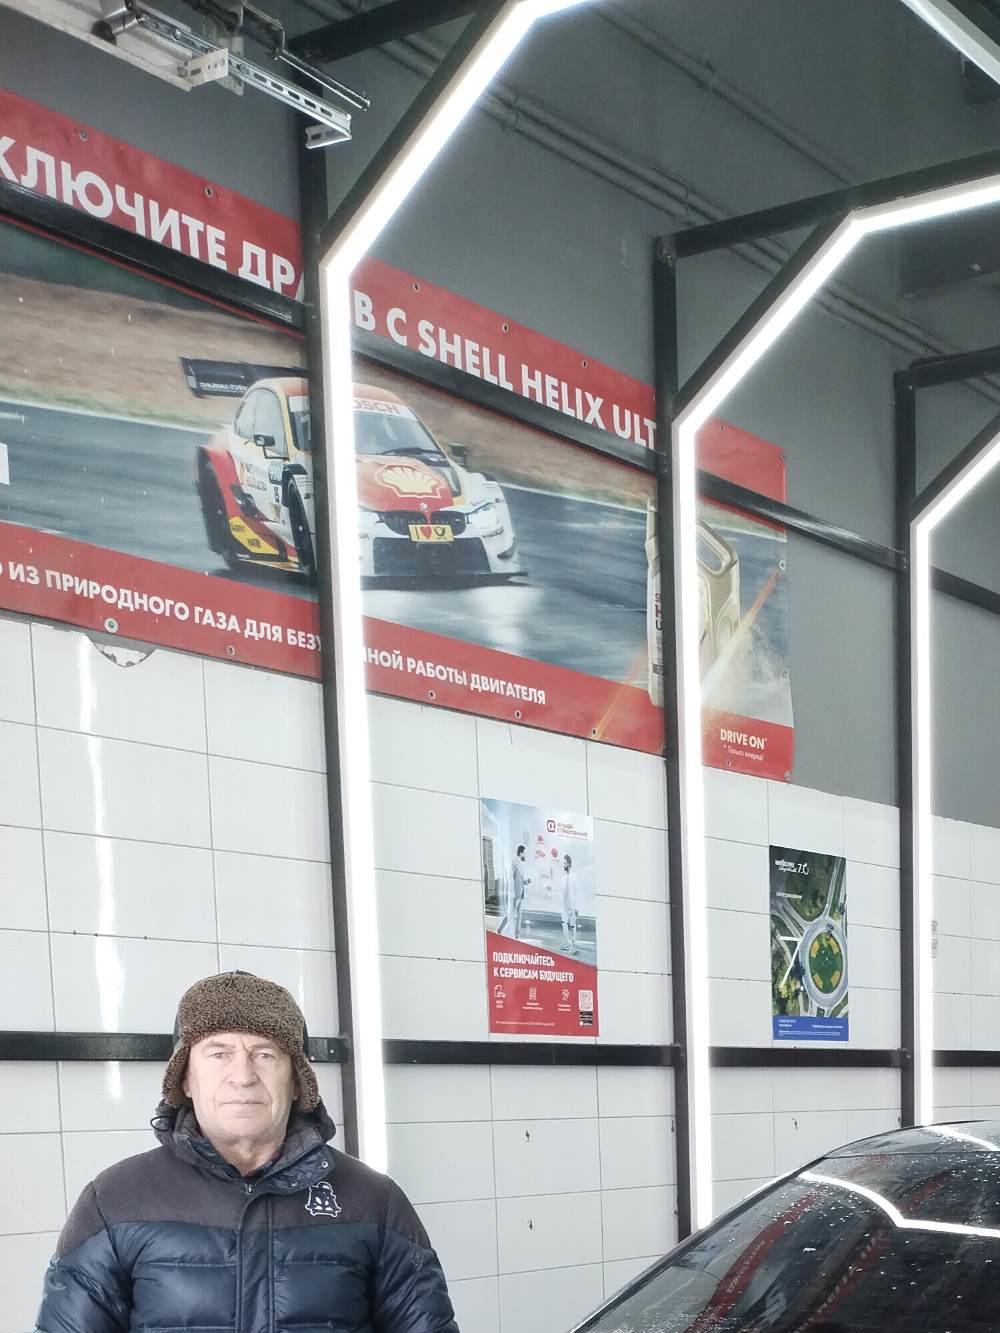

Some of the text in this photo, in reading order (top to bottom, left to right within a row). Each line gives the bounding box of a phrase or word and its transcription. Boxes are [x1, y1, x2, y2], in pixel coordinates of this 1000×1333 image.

[417, 319, 513, 392] SHELL
[521, 363, 606, 430] HELIX
[612, 404, 657, 450] ULT
[9, 561, 40, 585] ИЗ
[45, 569, 190, 620] ПРИРОДНОГО
[194, 606, 241, 633] ГАЗА
[244, 618, 283, 642] ДЛЯ
[406, 657, 468, 686] РАБОТЫ
[470, 673, 546, 704] ДВИГАТЕЛЯ
[720, 728, 748, 746] DRIVE
[492, 952, 556, 967] ПОДКЛЮЧАЙТЕСЬ
[493, 967, 574, 982] К СЕРВИСАМ БУДУЩЕГО
